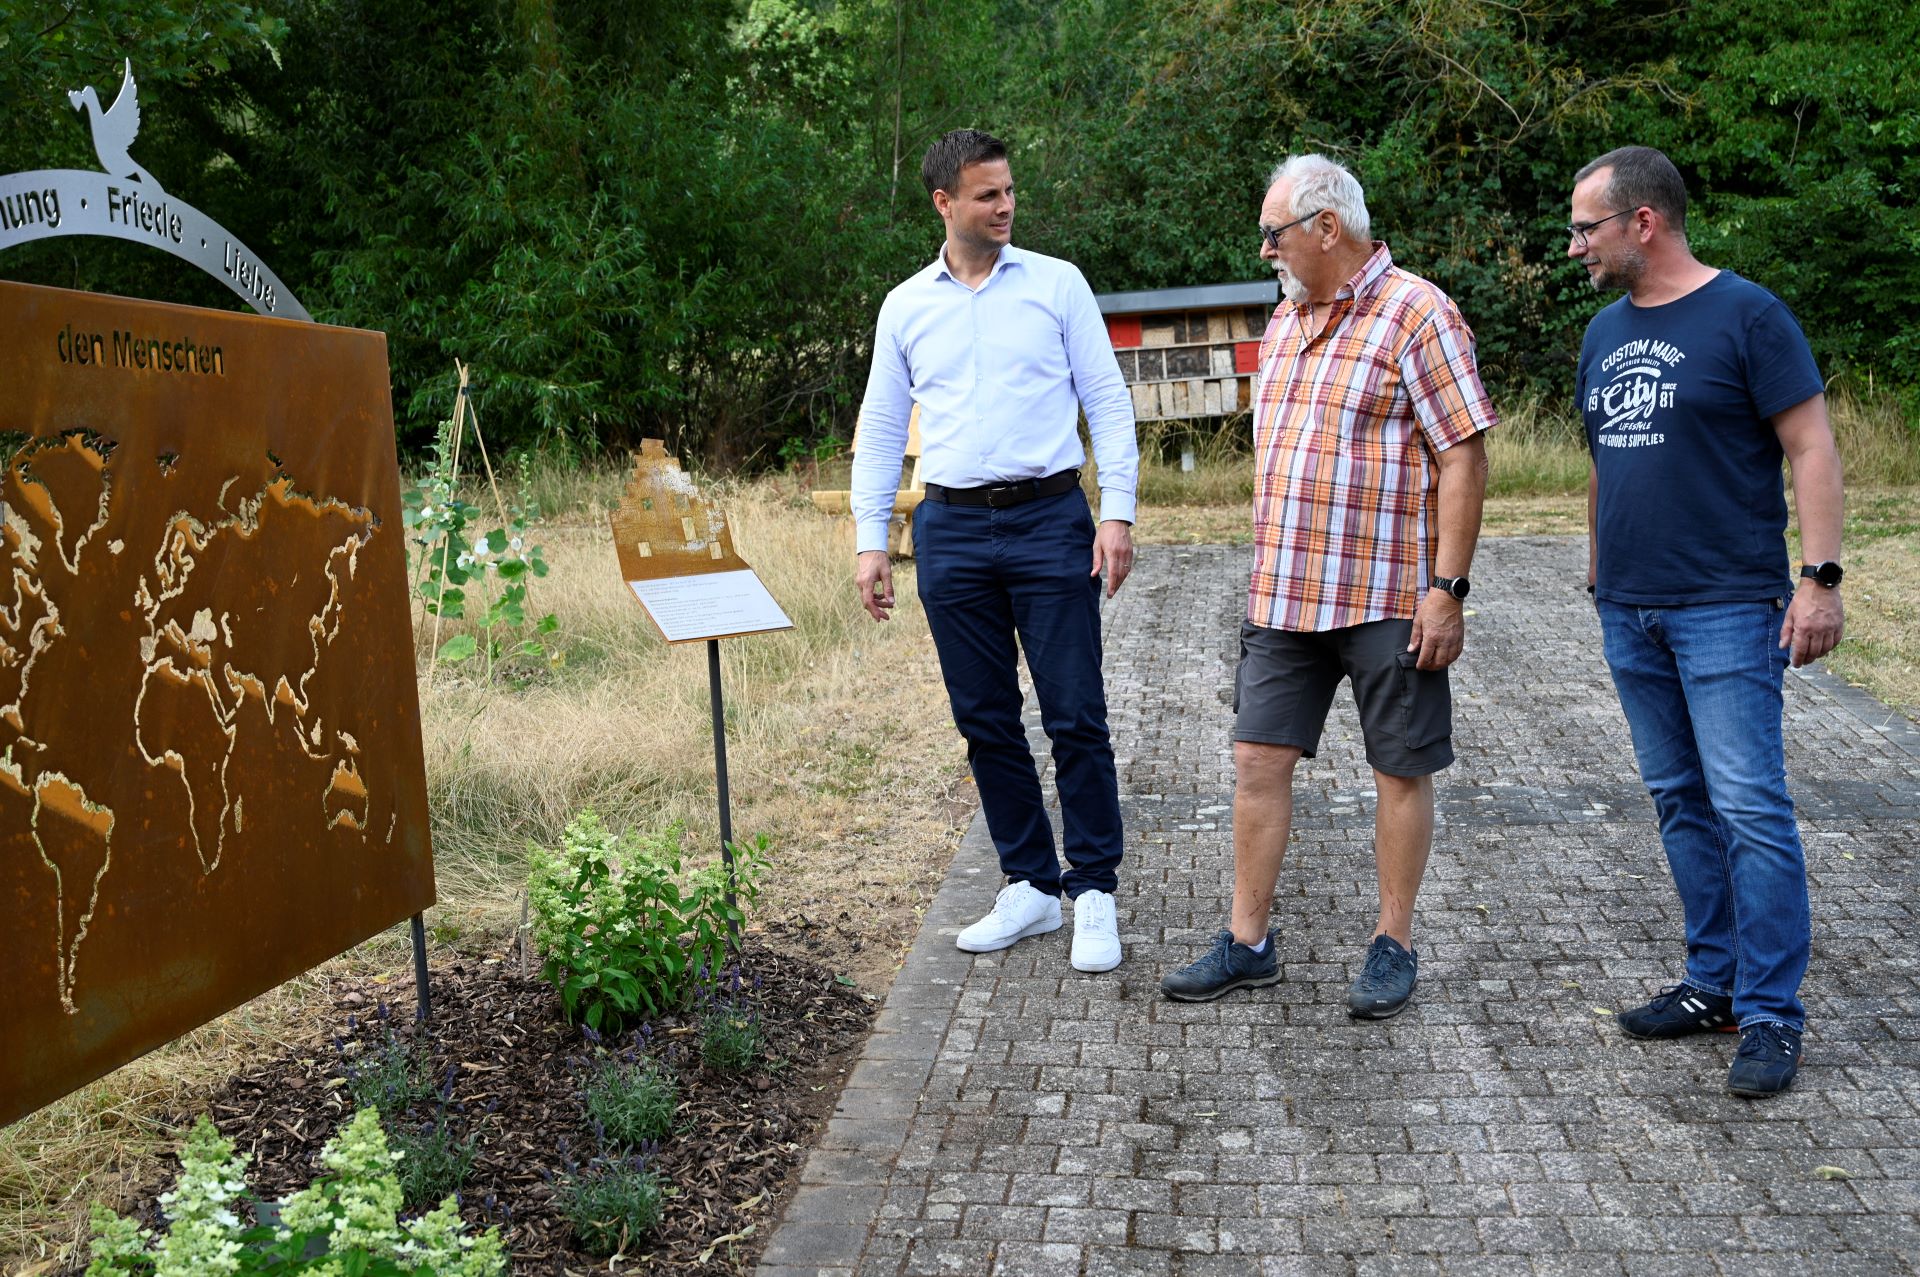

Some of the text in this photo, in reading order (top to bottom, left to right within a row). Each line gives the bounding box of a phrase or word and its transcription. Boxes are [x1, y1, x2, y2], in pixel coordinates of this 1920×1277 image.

[107, 187, 183, 244] Friede
[223, 241, 276, 313] Liebe
[57, 324, 225, 376] den Menschen
[1601, 339, 1686, 372] CUSTOM MADE
[1641, 357, 1661, 367] QUALITY
[1588, 395, 1598, 412] 19
[1601, 375, 1658, 419] City
[1659, 391, 1674, 409] 81
[1618, 421, 1653, 431] LIFESTYLE
[1607, 434, 1628, 448] GOODS
[1628, 433, 1665, 448] SUPPLIES
